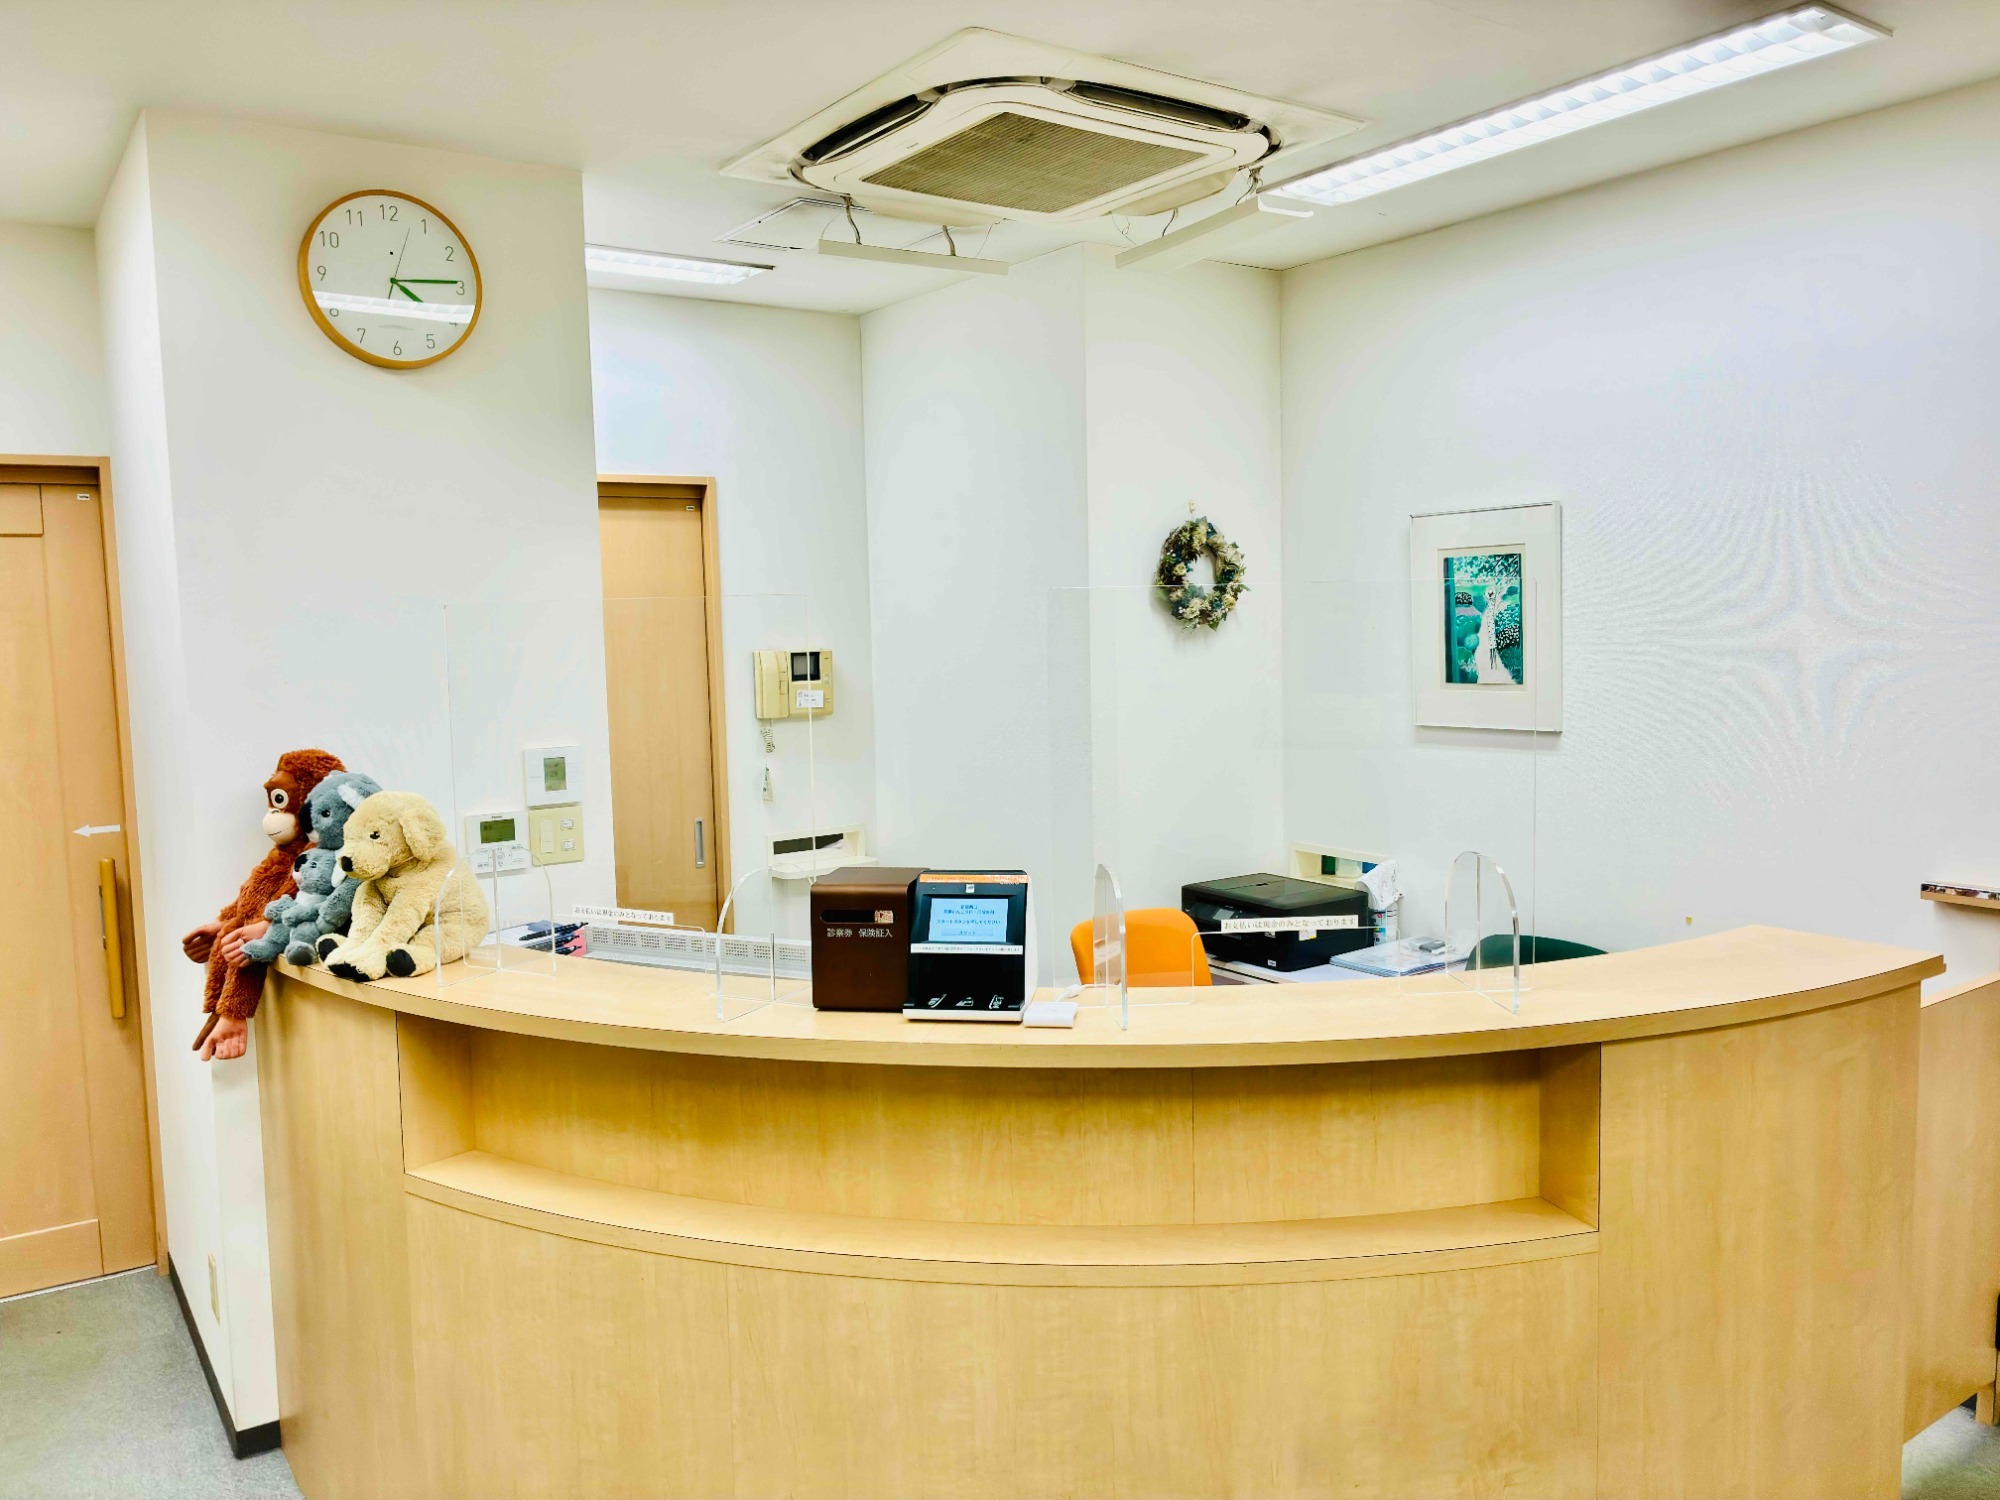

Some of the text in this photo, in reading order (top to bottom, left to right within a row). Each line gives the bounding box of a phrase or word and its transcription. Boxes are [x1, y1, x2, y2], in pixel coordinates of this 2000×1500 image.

[345, 208, 364, 227] 11
[379, 203, 399, 222] 12
[420, 218, 428, 235] 1
[318, 230, 340, 249] 10
[444, 245, 455, 262] 2
[316, 265, 327, 282] 9
[455, 280, 466, 296] 3
[356, 327, 367, 344] 7
[425, 333, 436, 349] 5
[392, 339, 403, 356] 6
[826, 927, 893, 938] 診察券 保険証入
[1223, 918, 1356, 930] お支払いは現金のみとなっております
